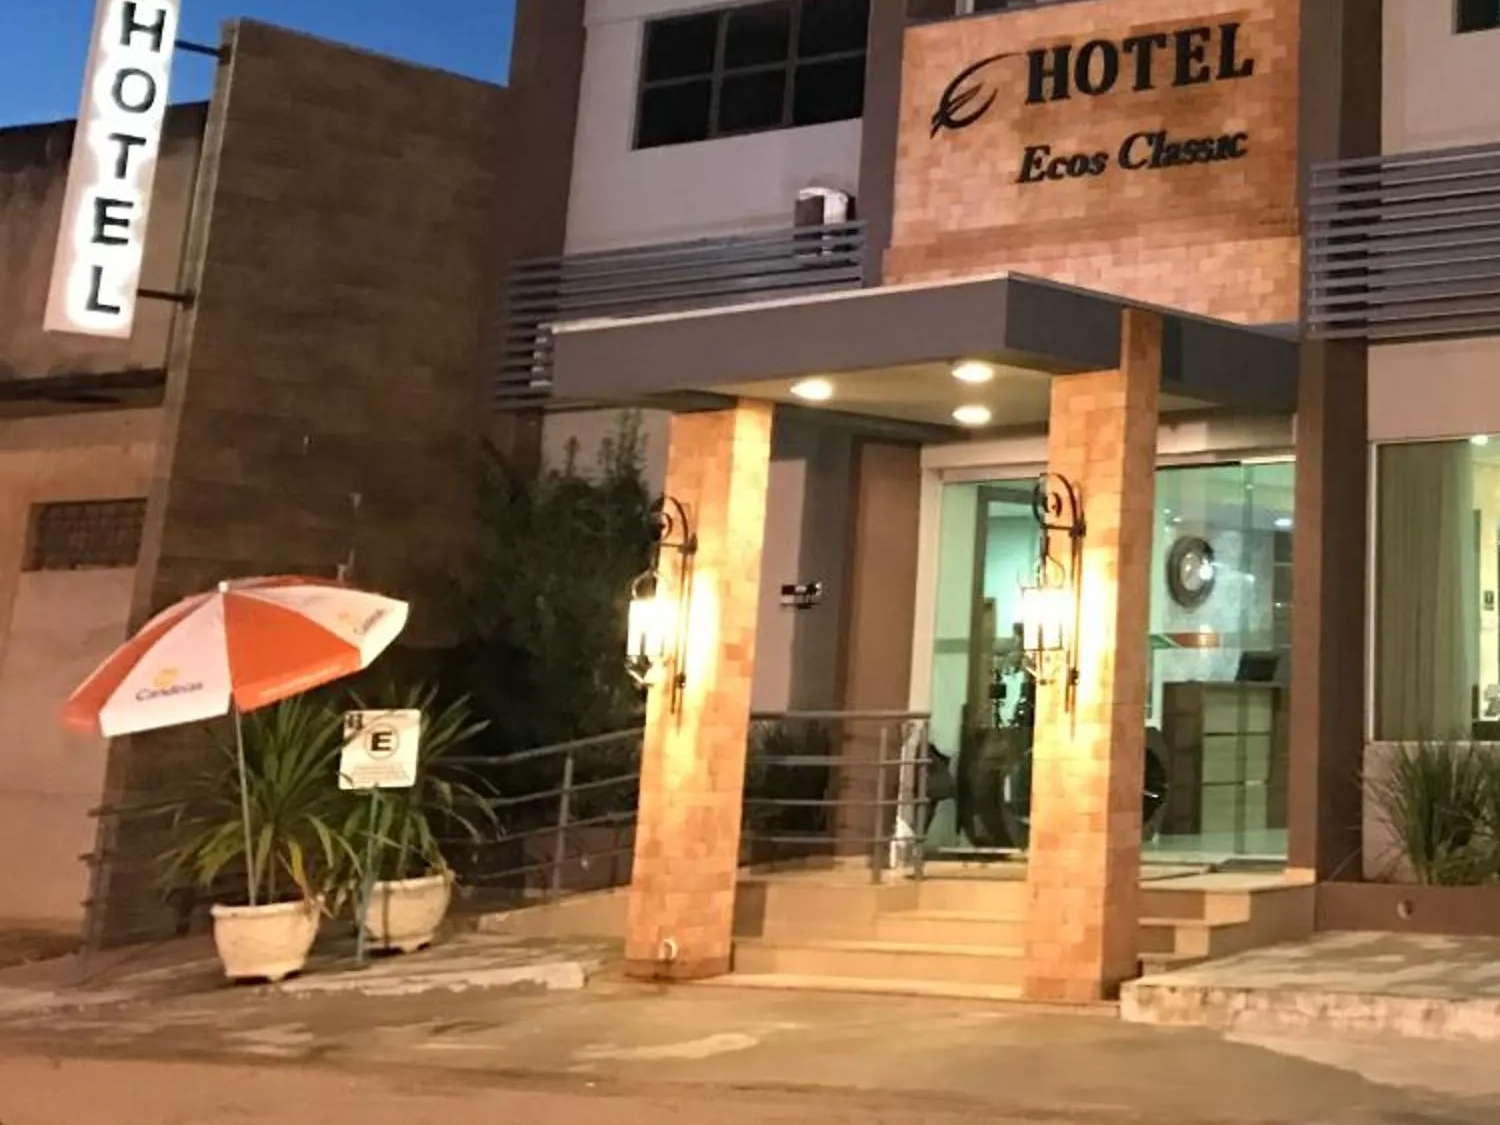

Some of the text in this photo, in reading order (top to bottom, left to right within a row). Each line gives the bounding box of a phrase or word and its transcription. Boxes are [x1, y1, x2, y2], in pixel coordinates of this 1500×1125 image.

[1024, 22, 1254, 106] HOTEL
[84, 1, 167, 315] HOTEL
[1015, 128, 1249, 184] Ecos Classic
[371, 731, 393, 751] E
